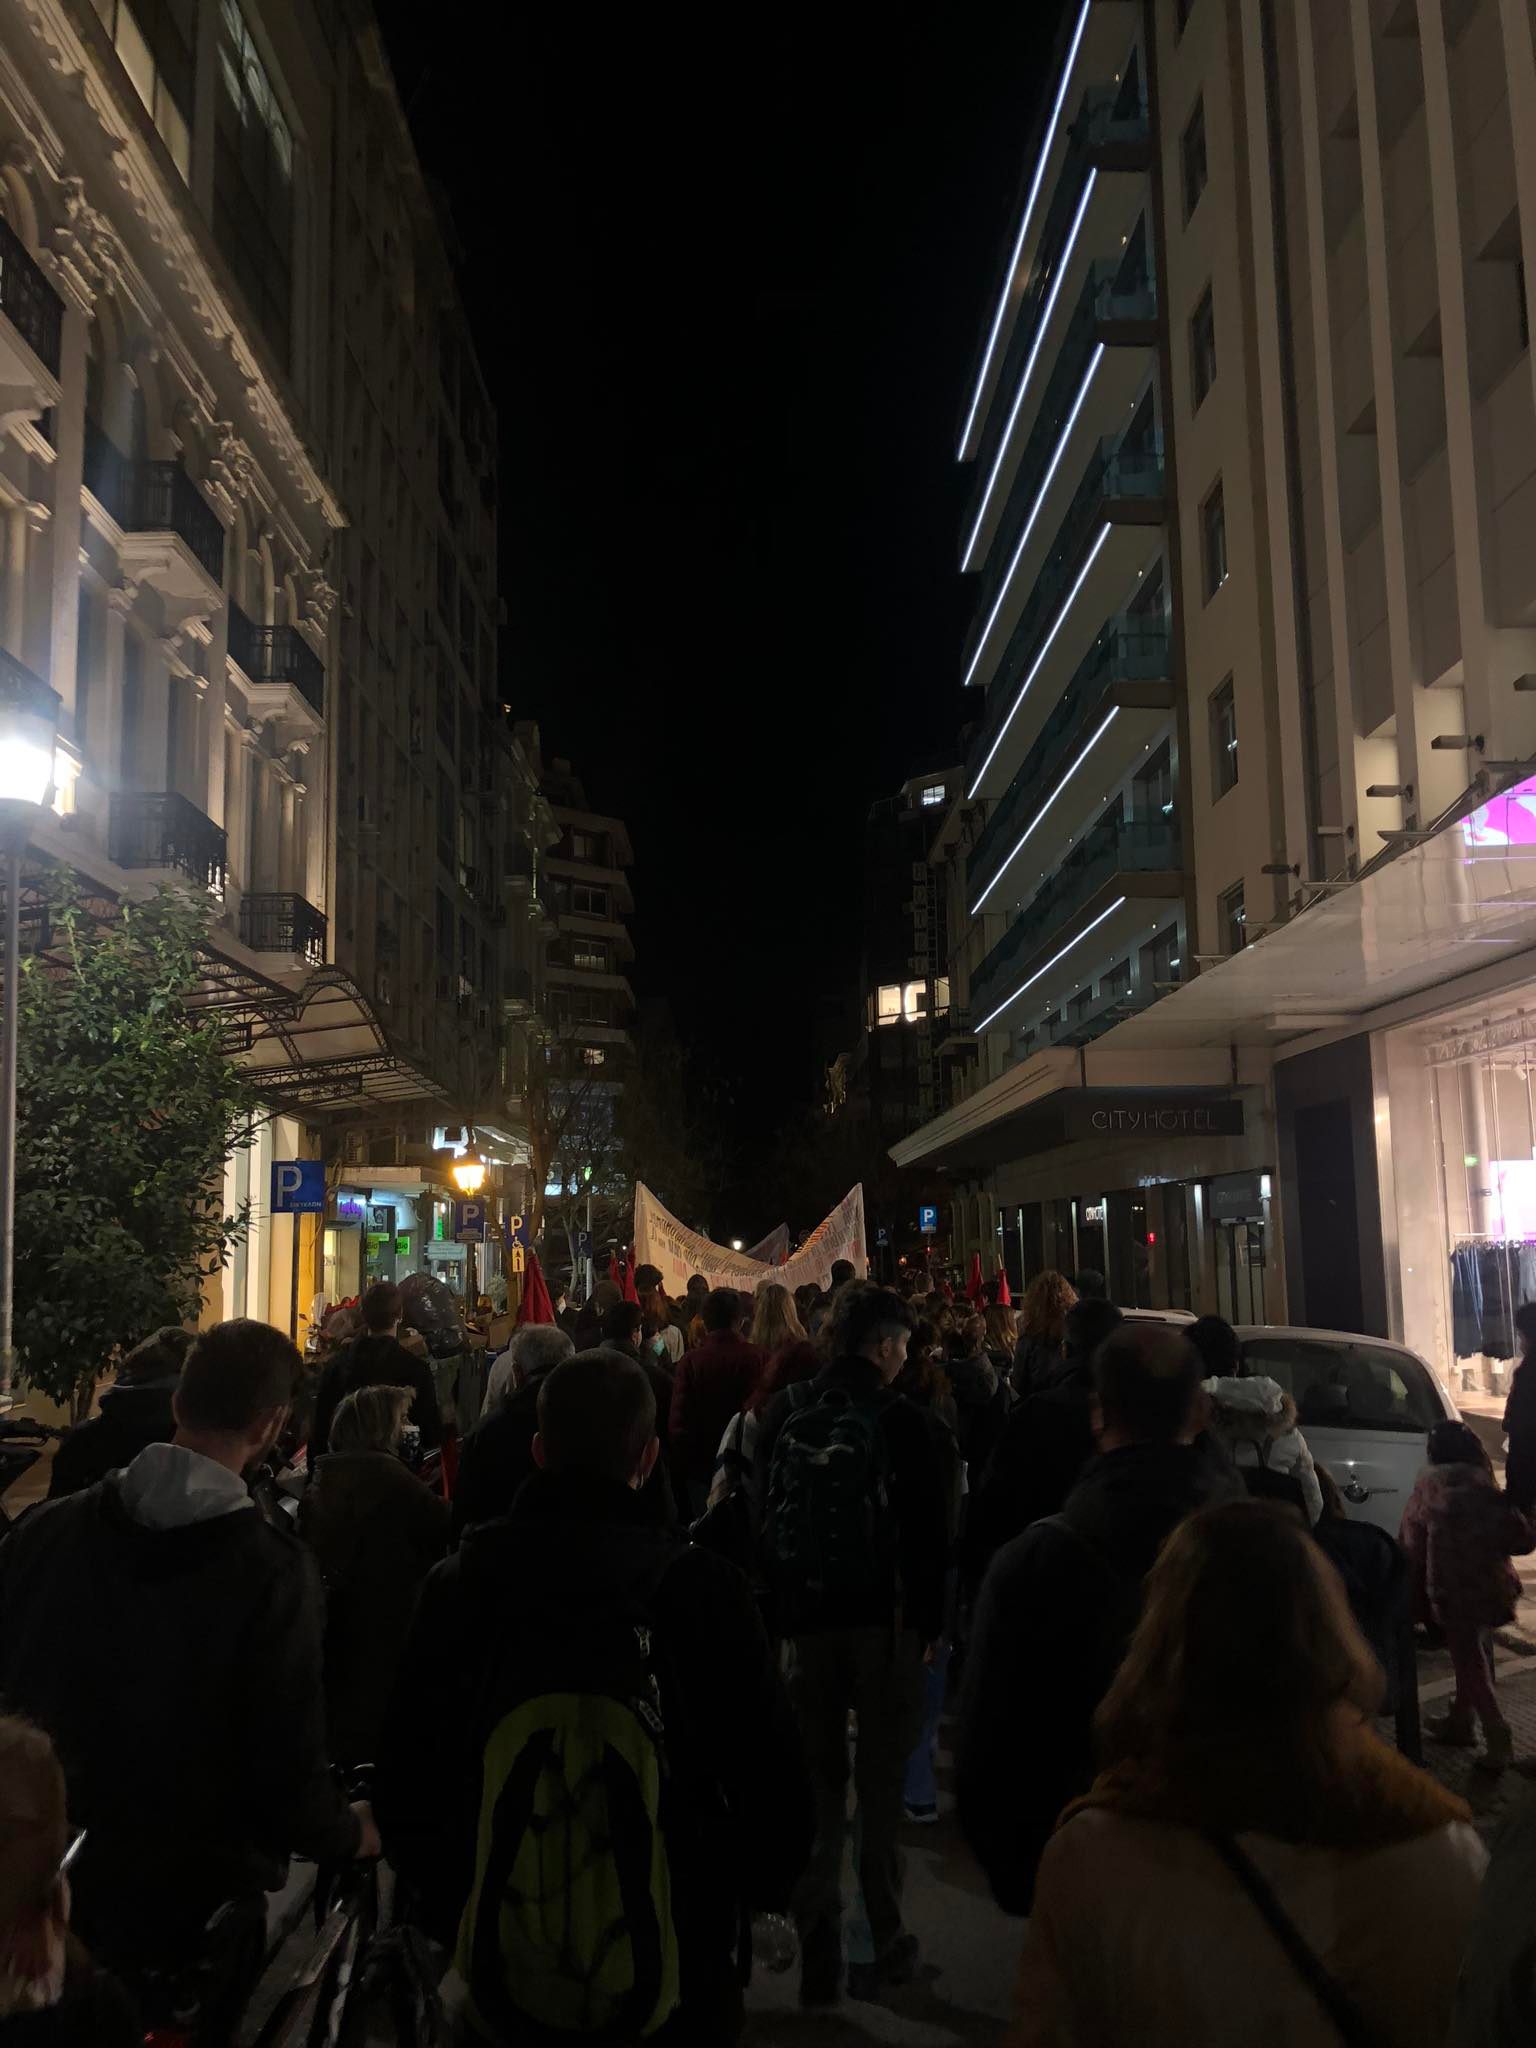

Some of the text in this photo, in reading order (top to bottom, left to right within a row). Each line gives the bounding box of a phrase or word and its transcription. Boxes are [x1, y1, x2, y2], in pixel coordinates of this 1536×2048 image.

[277, 1166, 302, 1207] P
[462, 1204, 479, 1226] P
[924, 1208, 934, 1223] P
[510, 1215, 523, 1236] P
[878, 1228, 886, 1239] P
[578, 1232, 588, 1247] P
